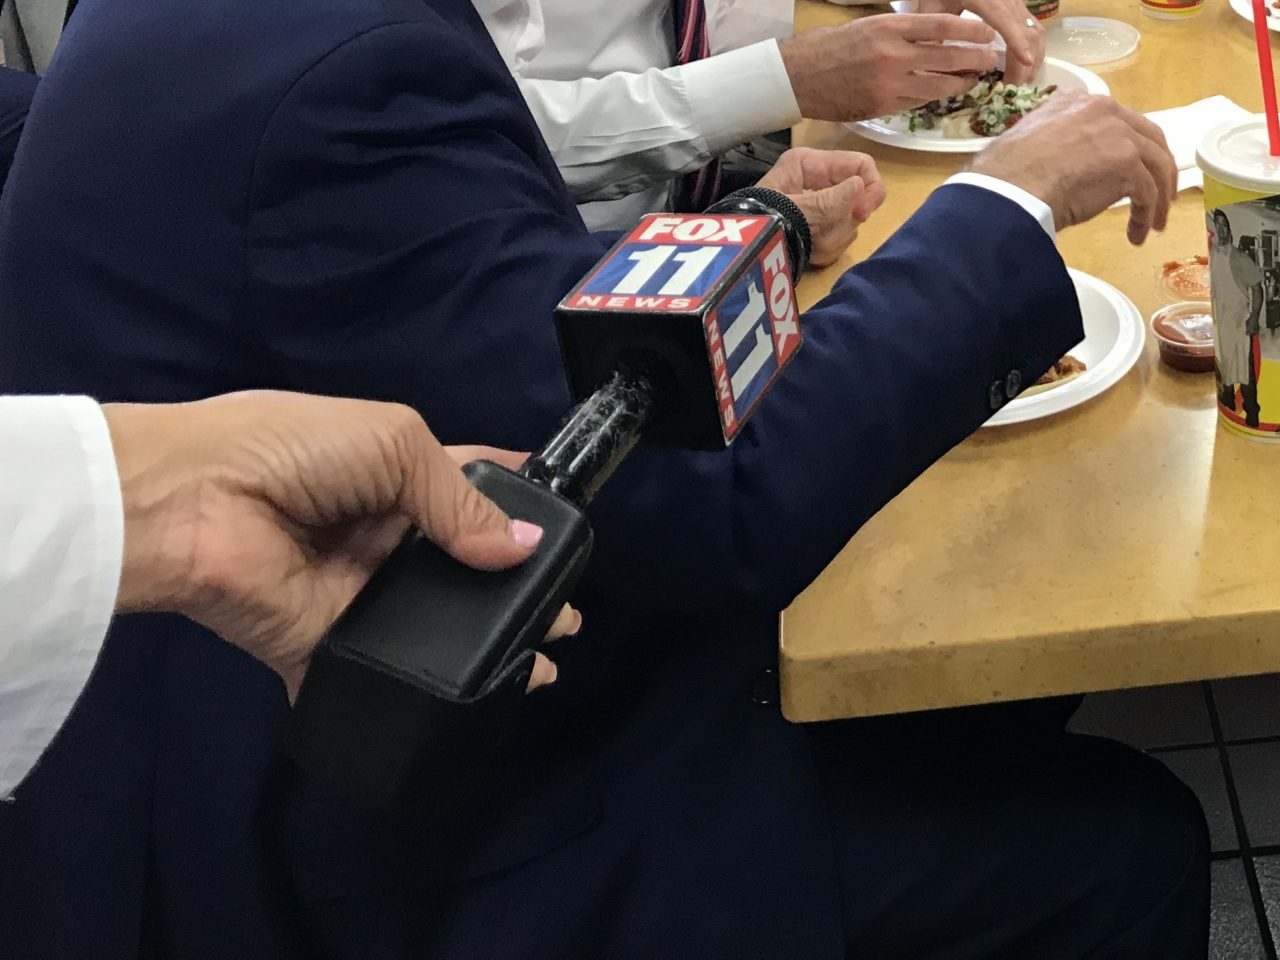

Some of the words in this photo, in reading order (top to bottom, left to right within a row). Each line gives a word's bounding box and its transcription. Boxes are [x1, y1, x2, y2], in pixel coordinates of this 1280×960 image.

[638, 217, 759, 243] FOX
[576, 296, 691, 308] NEWS
[611, 245, 722, 295] 11
[763, 243, 798, 357] FOX
[707, 320, 735, 428] NEWS
[722, 281, 774, 402] 11
